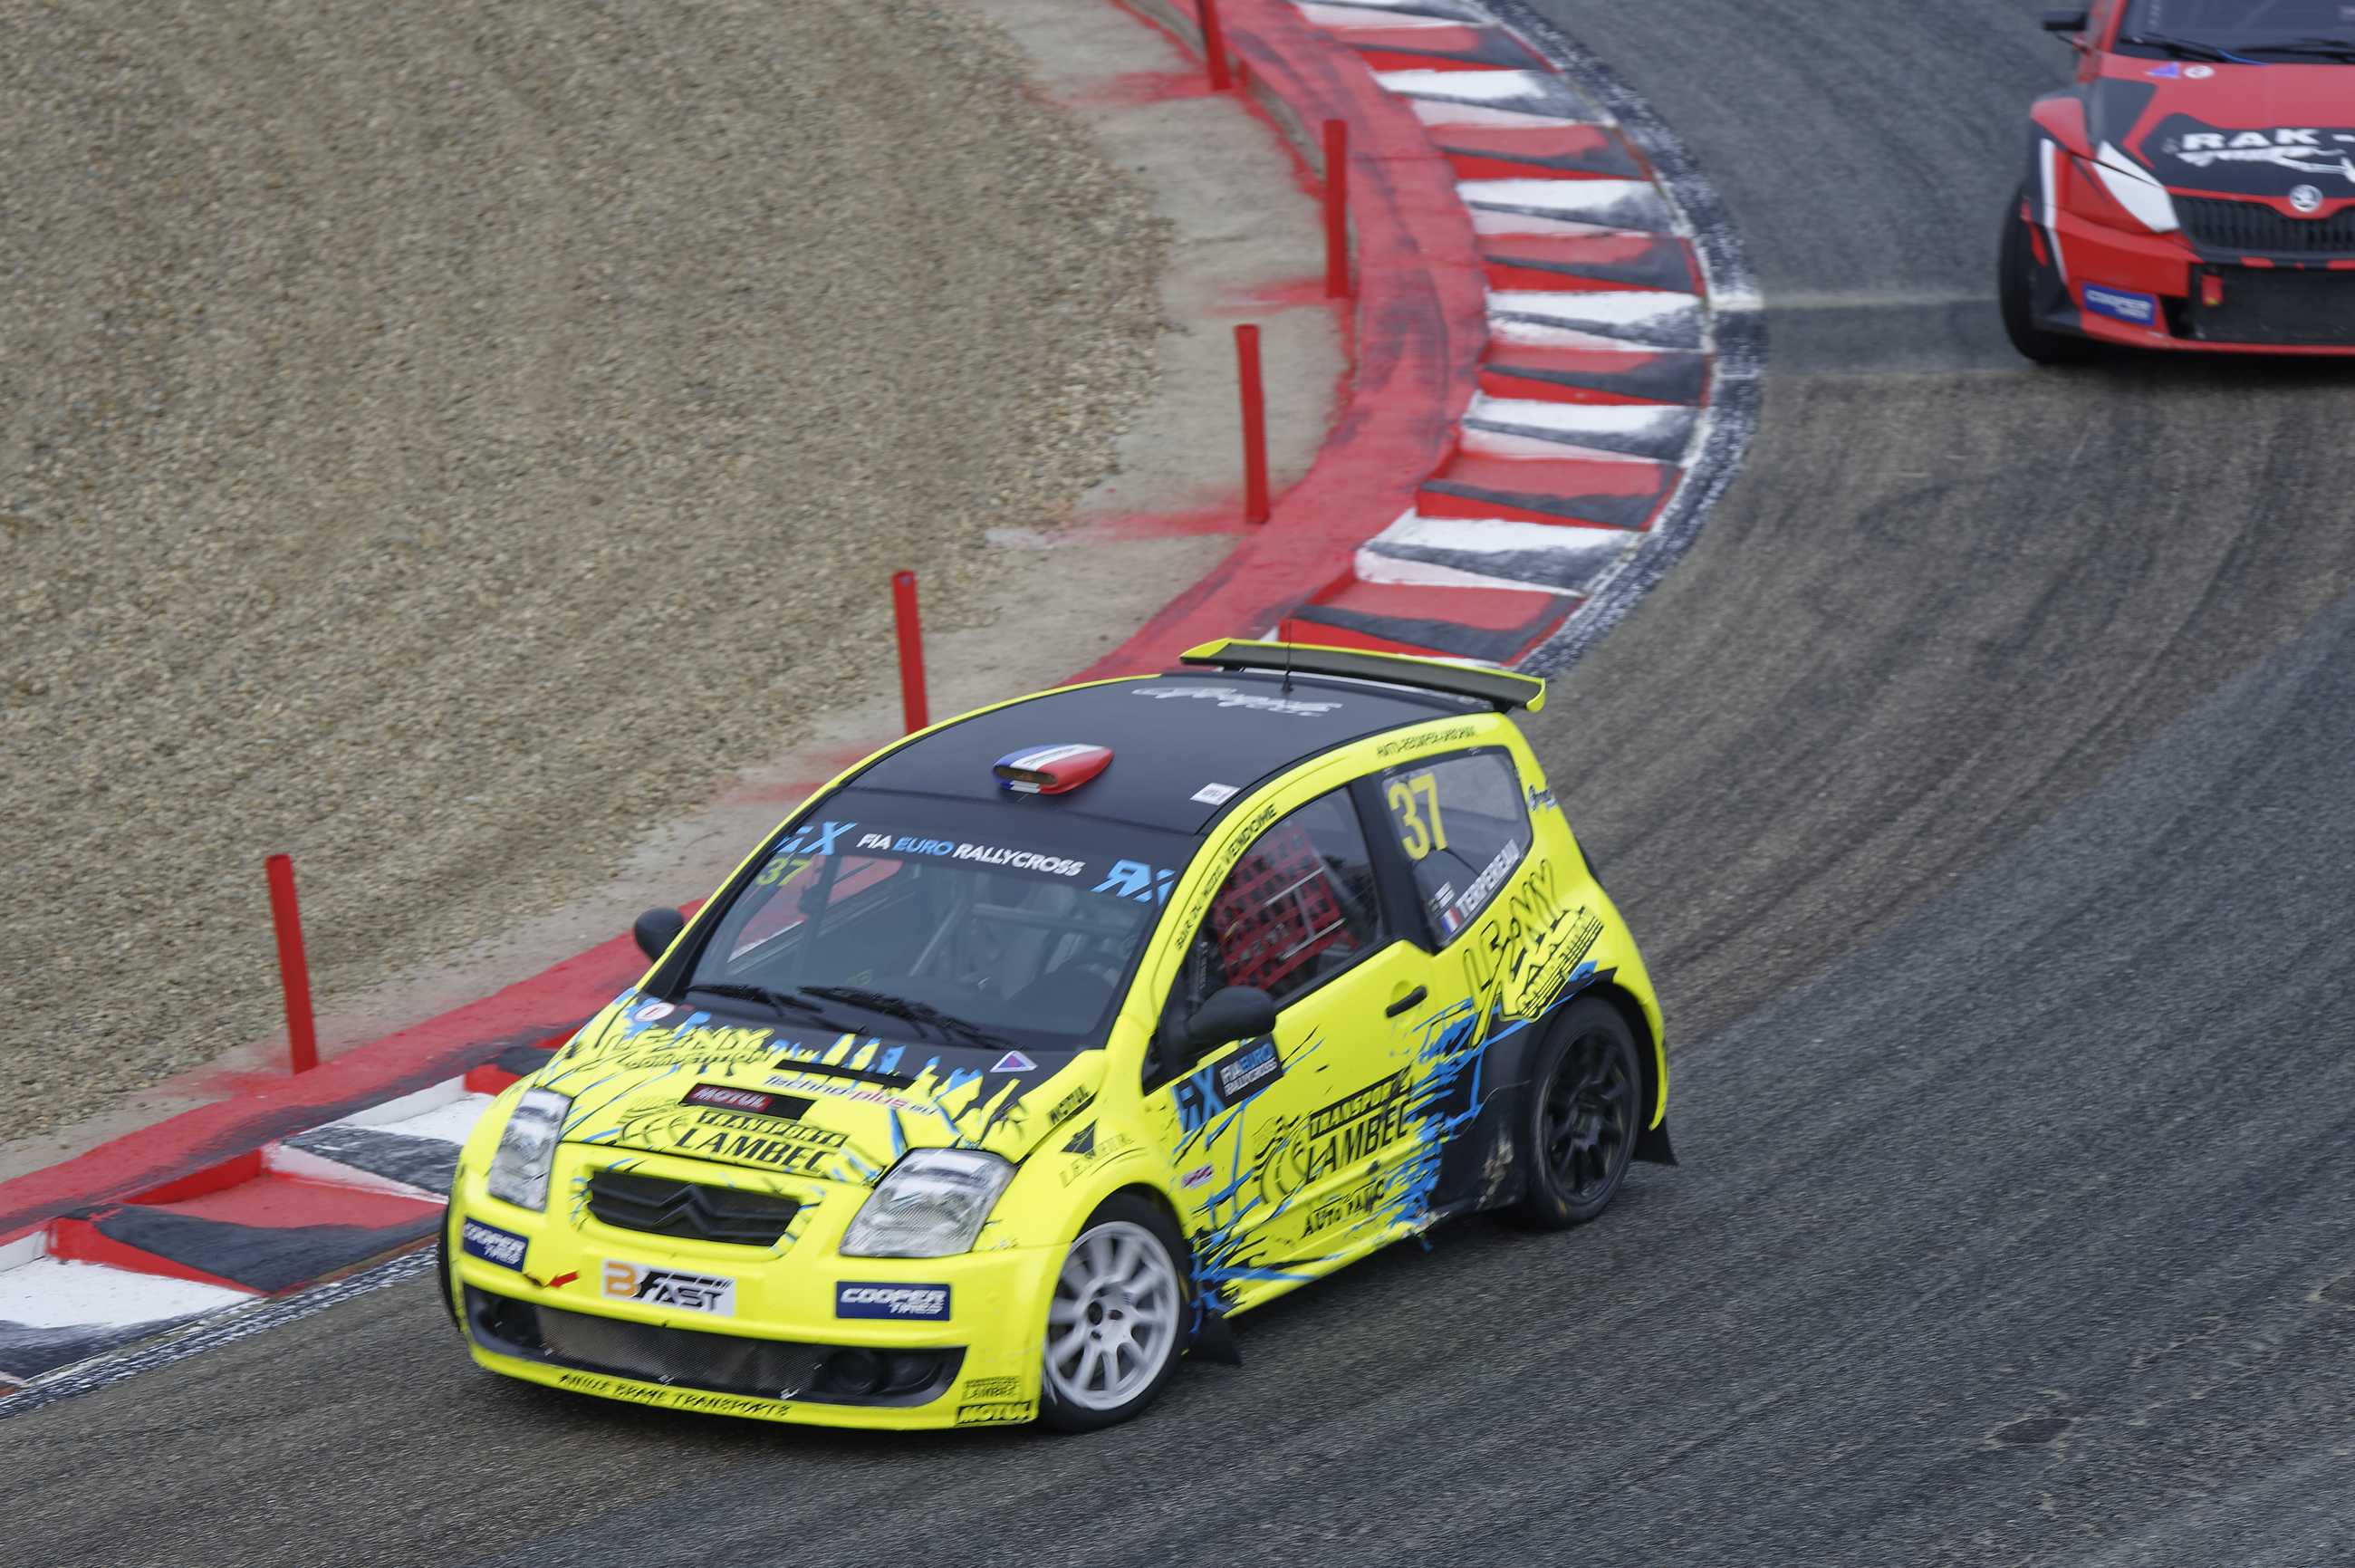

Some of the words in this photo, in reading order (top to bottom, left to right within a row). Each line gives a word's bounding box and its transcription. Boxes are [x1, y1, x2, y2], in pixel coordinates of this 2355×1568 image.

[1388, 773, 1447, 860] 37
[856, 833, 892, 850] FIA
[891, 837, 955, 855] EURO
[951, 843, 1086, 876] RALLYCROSS
[756, 858, 812, 886] 37
[693, 1087, 769, 1109] MOTUL
[464, 1223, 526, 1254] COOPER
[840, 1287, 948, 1304] COOPER
[889, 1301, 943, 1314] TIRES
[673, 1393, 791, 1417] TRANSPORTS
[956, 1403, 1030, 1424] MOTUL
